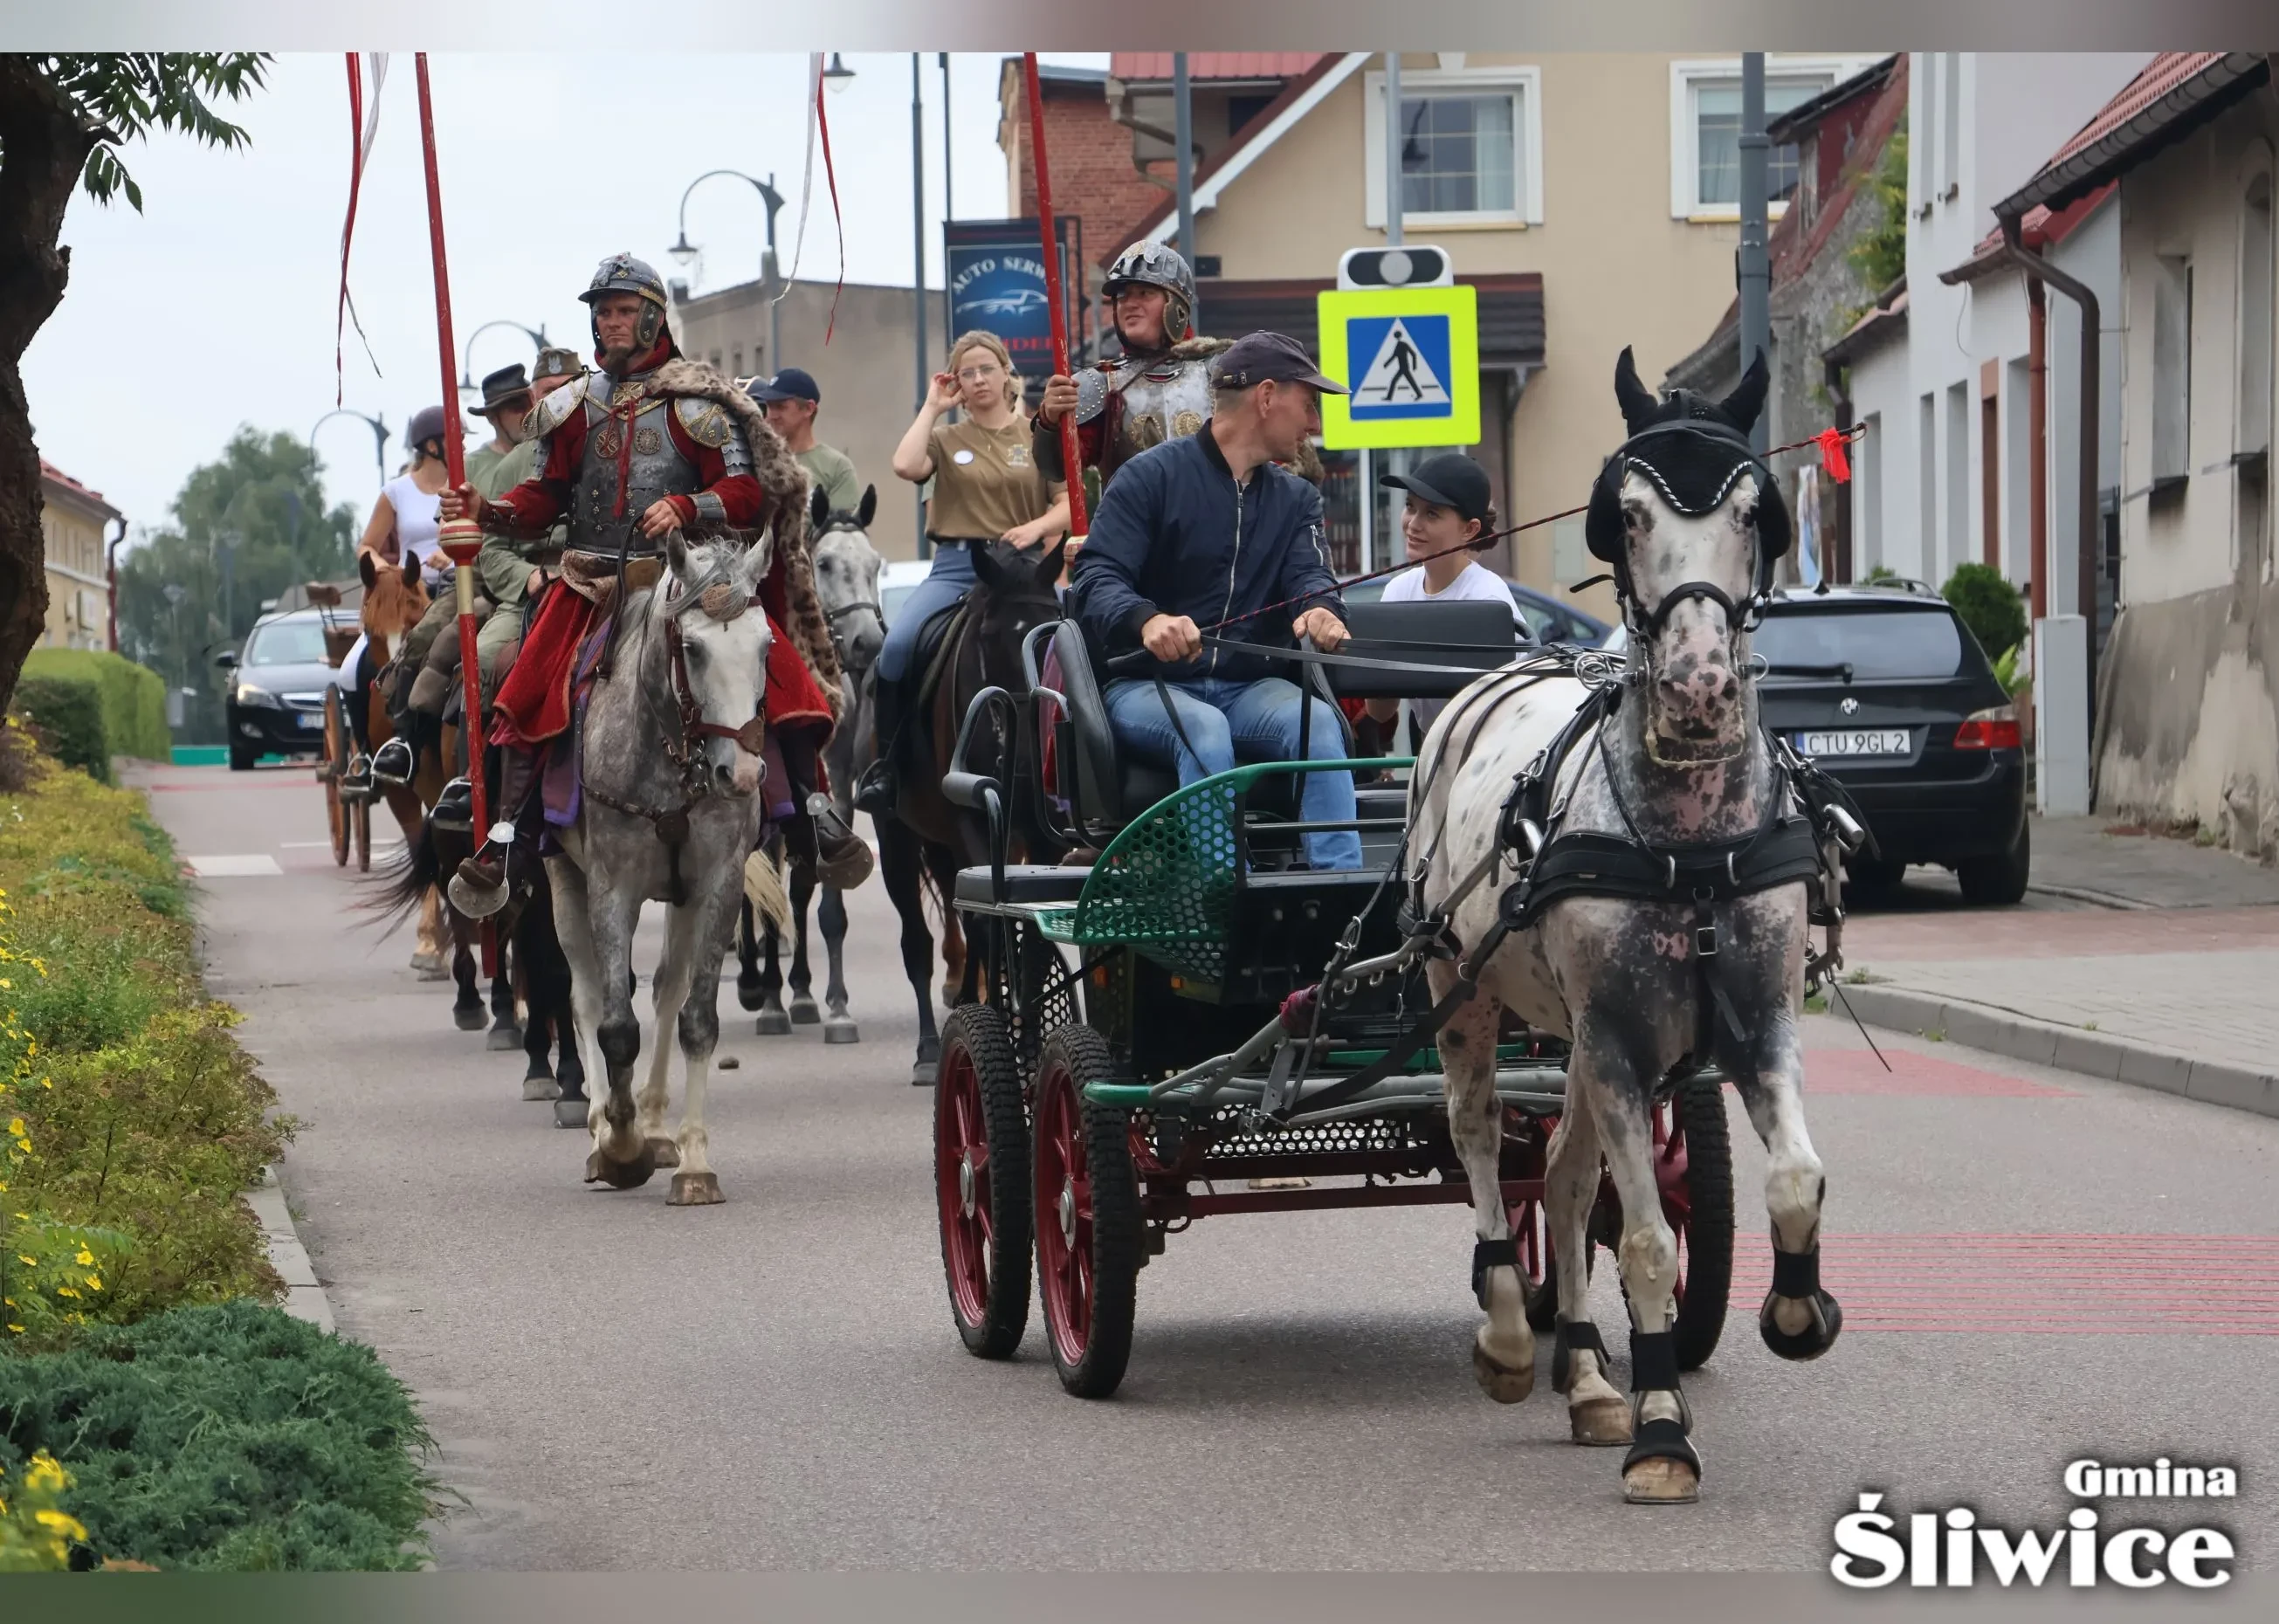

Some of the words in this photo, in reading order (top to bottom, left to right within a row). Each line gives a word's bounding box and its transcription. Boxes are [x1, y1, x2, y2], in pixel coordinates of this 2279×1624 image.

[953, 258, 996, 294] AUTO
[1809, 734, 1848, 754] CTU
[1855, 733, 1905, 754] 9GL2
